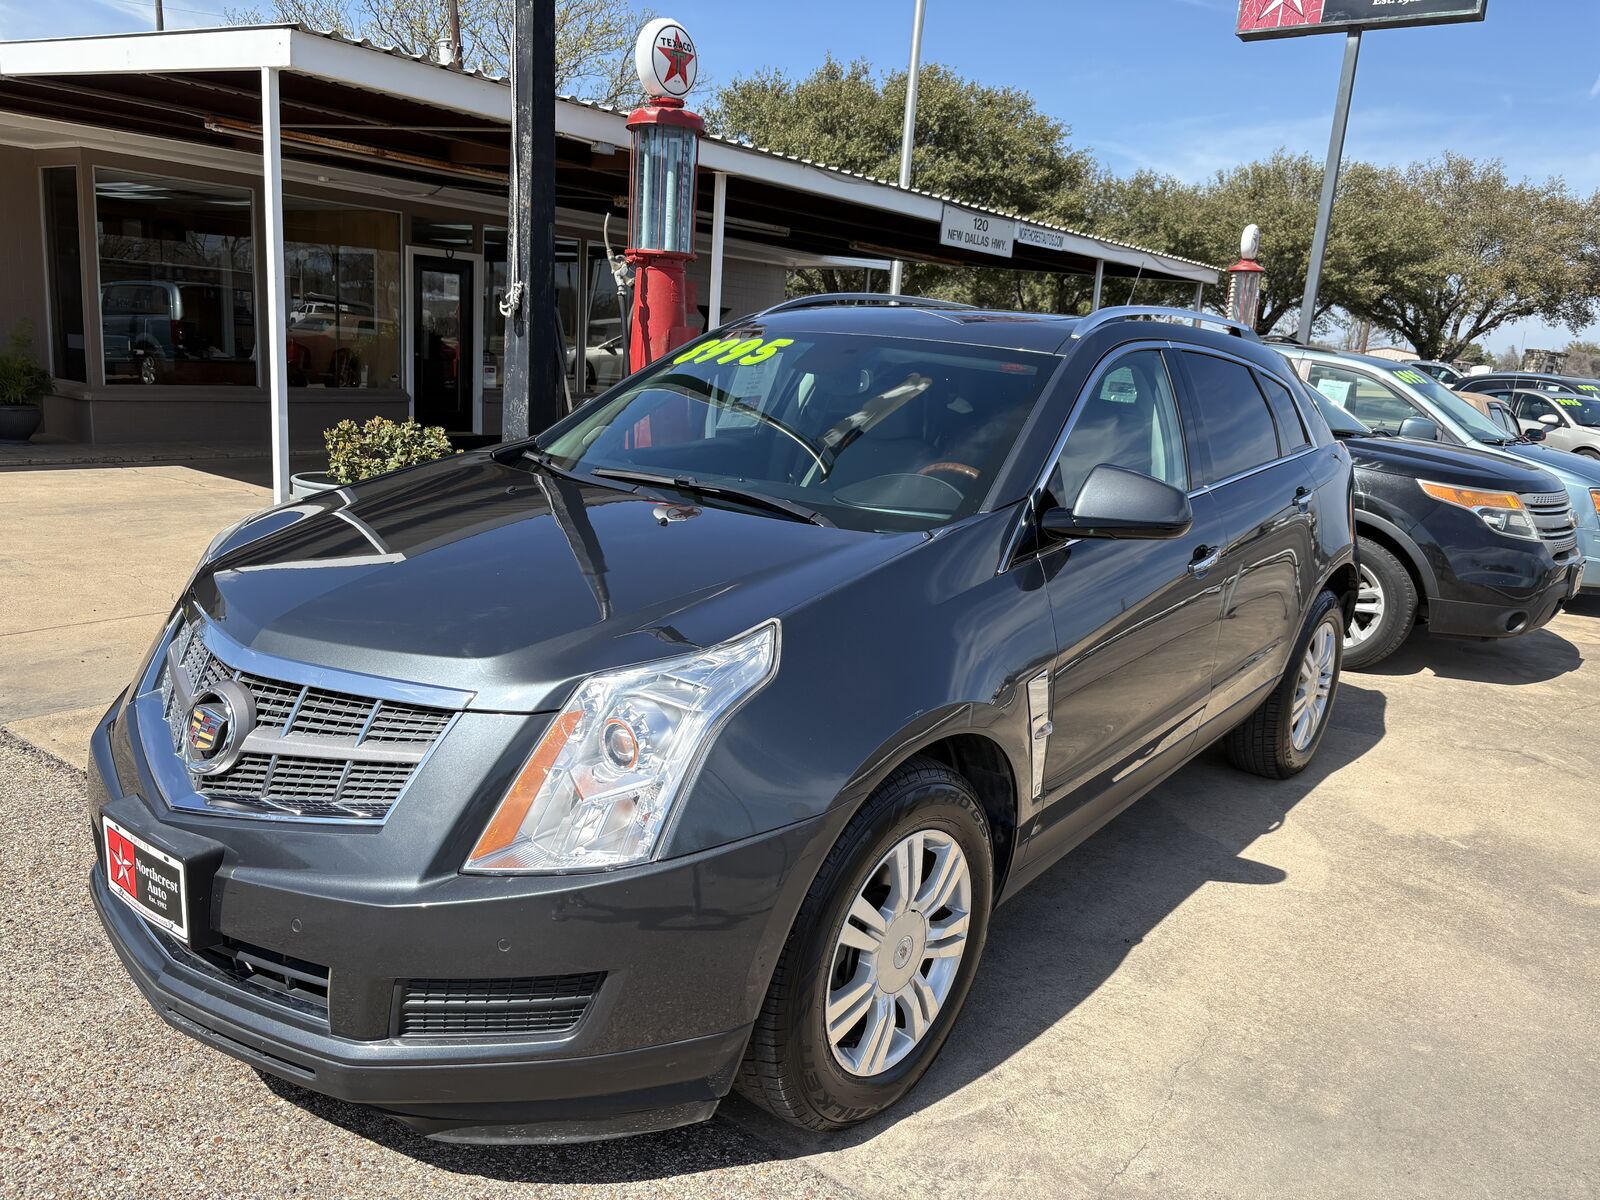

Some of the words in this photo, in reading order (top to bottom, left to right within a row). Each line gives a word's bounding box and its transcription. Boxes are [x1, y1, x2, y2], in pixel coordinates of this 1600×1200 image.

[660, 37, 692, 53] TEXACO
[670, 50, 687, 74] T
[972, 217, 989, 232] 120
[947, 229, 963, 242] NEW
[964, 232, 990, 248] DALLAS
[991, 237, 1007, 252] HWY.
[673, 338, 795, 366] 8995
[135, 857, 179, 894] Northcrest
[147, 880, 167, 901] Auto
